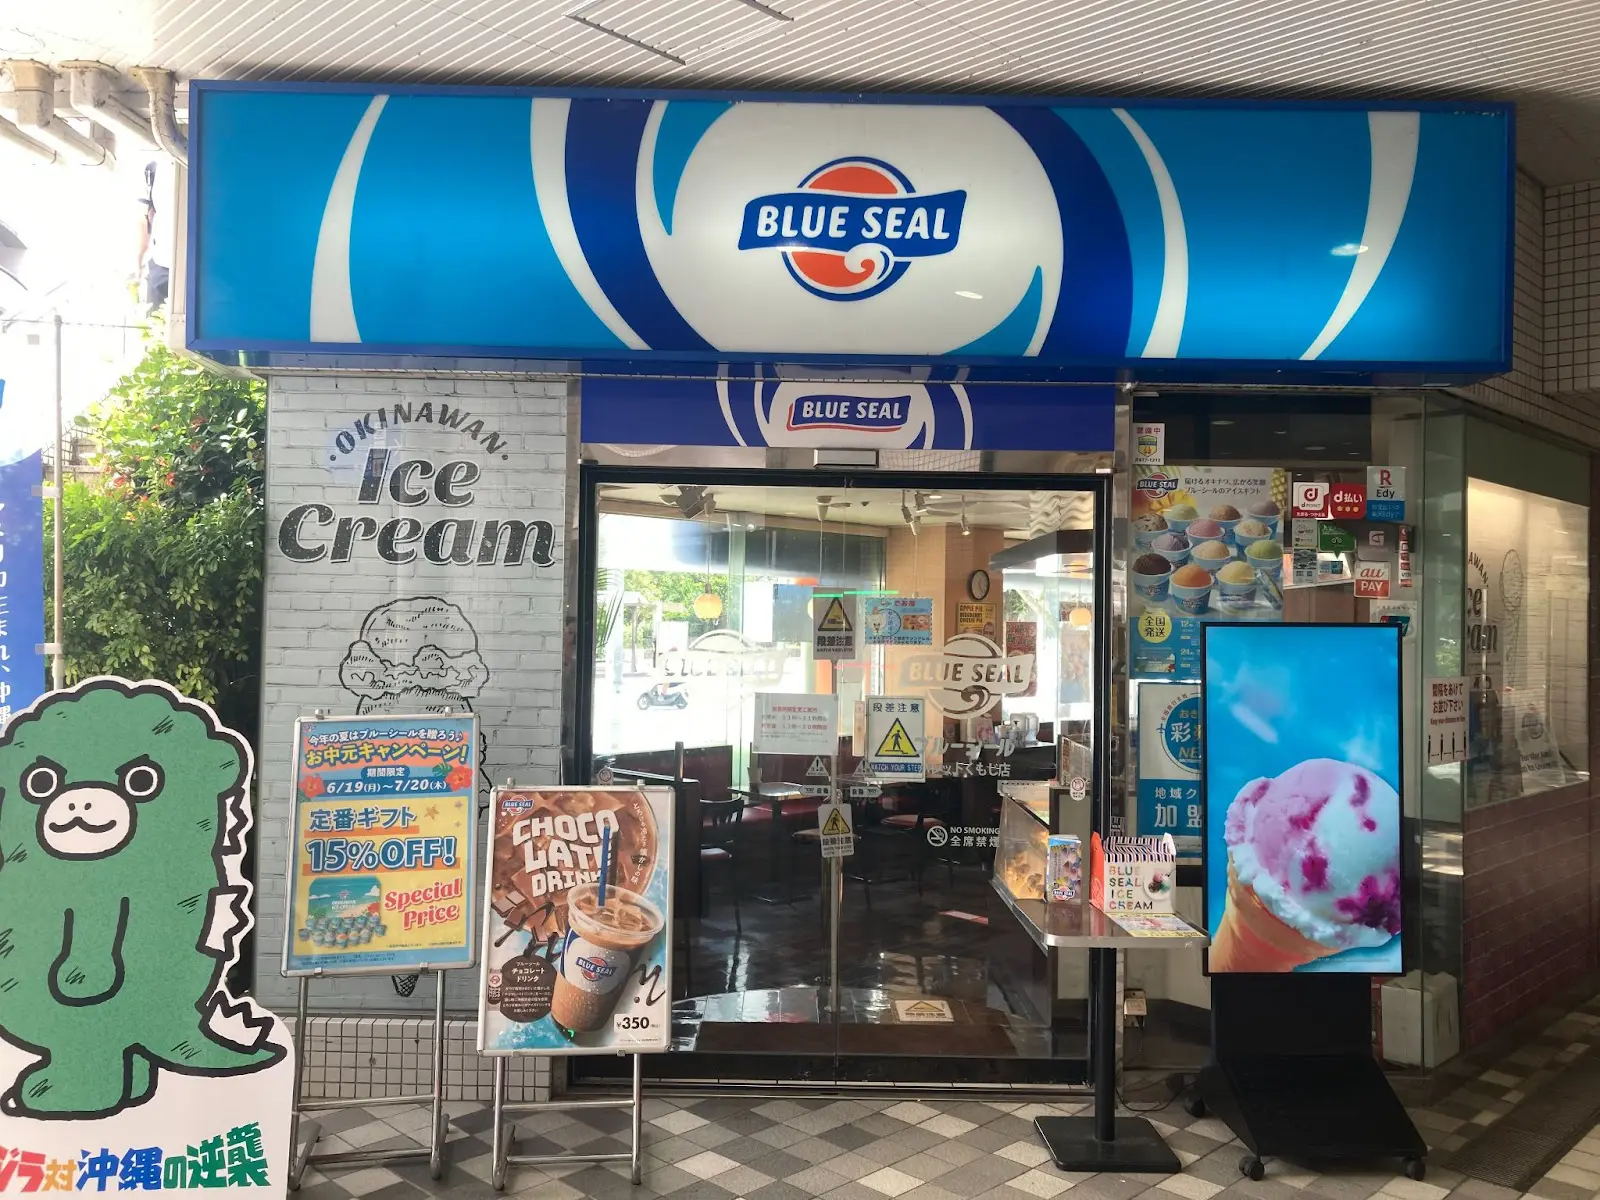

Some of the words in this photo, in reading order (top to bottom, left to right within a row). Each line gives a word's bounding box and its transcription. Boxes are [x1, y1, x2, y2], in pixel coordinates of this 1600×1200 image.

[757, 205, 849, 238] BLUE
[861, 206, 950, 240] SEAL
[802, 401, 850, 418] BLUE
[856, 402, 901, 419] SEAL
[335, 402, 508, 455] OKINAWAN
[357, 447, 481, 507] Ice
[1380, 469, 1392, 485] R
[1139, 480, 1157, 488] BLUE
[1159, 481, 1176, 489] SEAL
[1333, 491, 1363, 503] d払い
[1376, 489, 1395, 499] Edy
[278, 503, 556, 568] Cream
[1360, 568, 1385, 577] au
[1361, 581, 1384, 591] PAY
[1145, 616, 1165, 626] 全国
[1145, 627, 1166, 637] 発送
[909, 662, 963, 681] BLUE
[971, 663, 1024, 683] SEAL
[873, 703, 920, 713] 段差注意
[306, 742, 469, 767] お中元キャンペーン!
[1179, 747, 1201, 759] NE
[366, 767, 405, 777] 期間限定
[872, 763, 888, 771] WATCH
[1155, 787, 1198, 799] 地域ク
[309, 806, 416, 832] 定番ギフト
[513, 810, 619, 845] CHOCO
[964, 827, 1000, 835] SMOKING
[950, 836, 1000, 848] 全席禁煙
[1109, 866, 1140, 875] BLUE
[1110, 878, 1141, 887] SEAL
[384, 878, 463, 911] Special
[1111, 889, 1133, 898] ICE
[1110, 901, 1153, 910] CREAM
[403, 904, 460, 930] Price
[578, 959, 595, 970] BLUE
[596, 967, 613, 975] SEAL
[617, 1016, 650, 1030] ¥350
